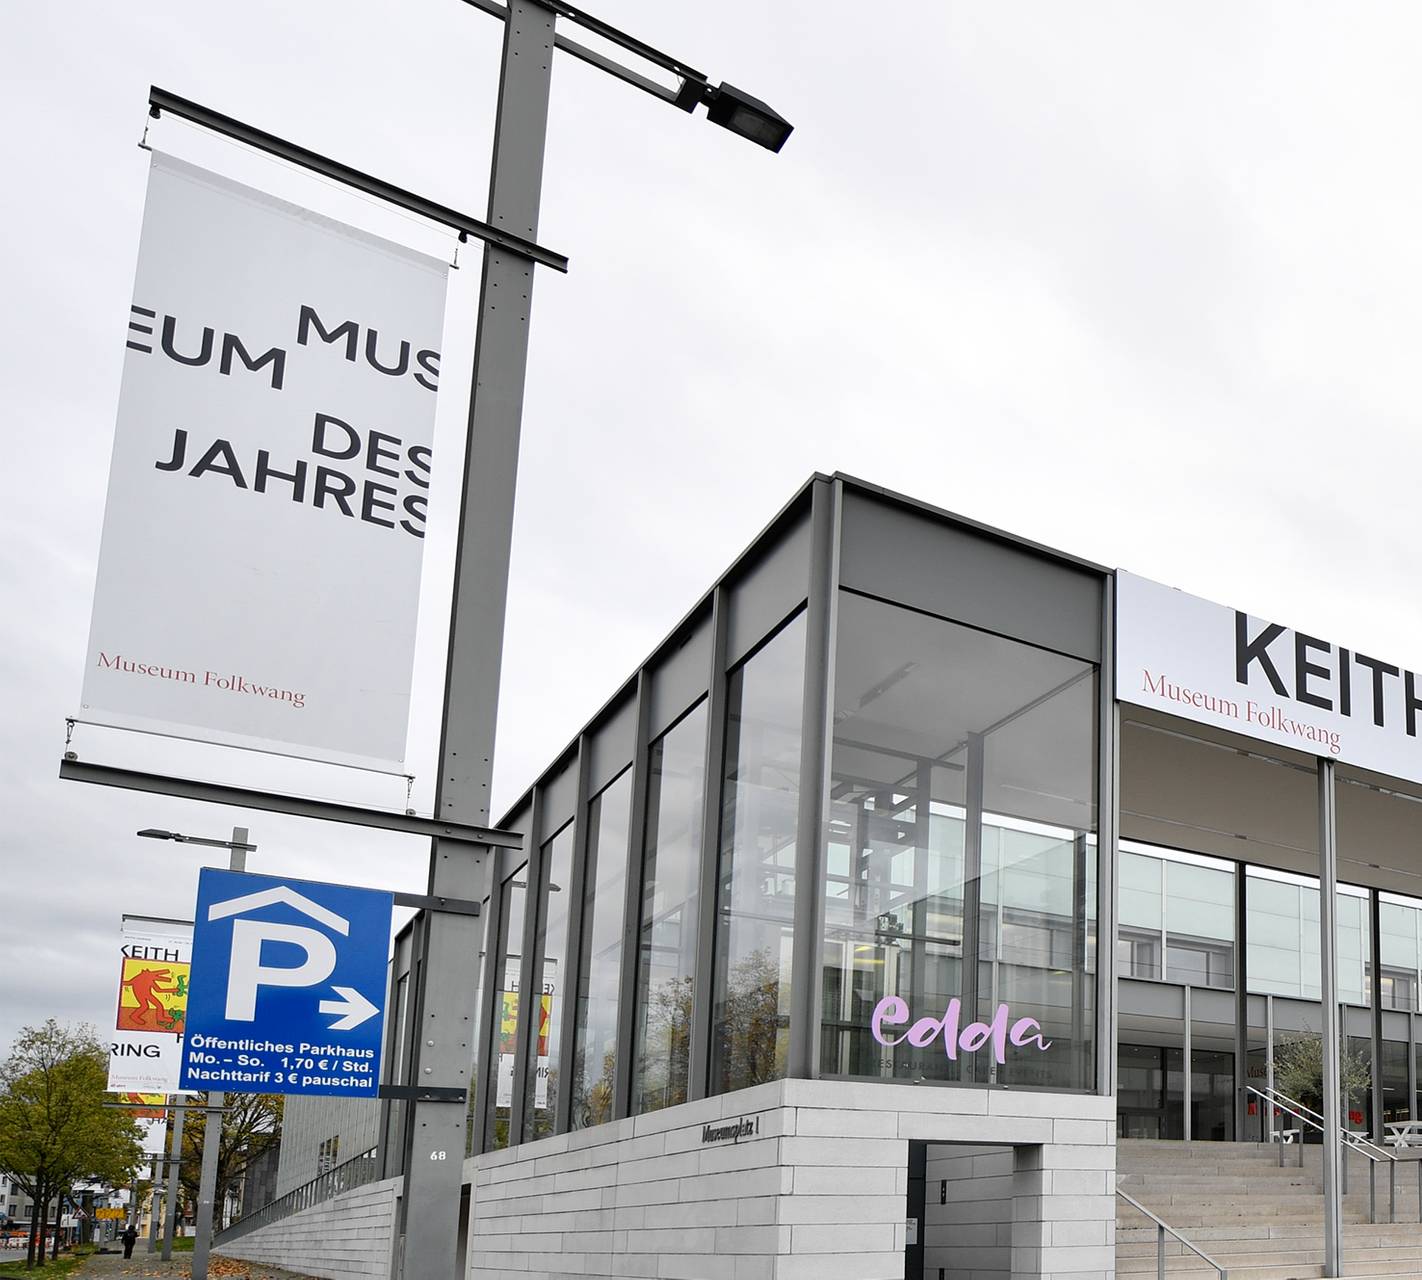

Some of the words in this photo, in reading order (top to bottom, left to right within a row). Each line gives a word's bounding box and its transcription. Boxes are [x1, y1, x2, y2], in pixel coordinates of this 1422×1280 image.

[126, 304, 287, 390] EUM
[296, 304, 441, 392] MUS
[154, 428, 428, 539] JAHRES
[311, 412, 433, 489] DES
[97, 652, 196, 684] Museum
[204, 671, 306, 709] Folkwang
[1142, 669, 1239, 719] Museum
[1246, 701, 1342, 754] Folkwang
[224, 918, 338, 1023] P
[189, 1051, 220, 1065] Mo.
[237, 1054, 265, 1067] So.
[280, 1057, 314, 1070] 1,70
[342, 1060, 374, 1073] Std.
[190, 1033, 294, 1053] Öffentliches
[299, 1042, 375, 1059] Parkhaus
[871, 995, 1053, 1064] edda
[187, 1067, 270, 1083] Nachttarif
[274, 1072, 284, 1083] 3
[302, 1075, 373, 1089] pauschal
[430, 1151, 446, 1160] 68
